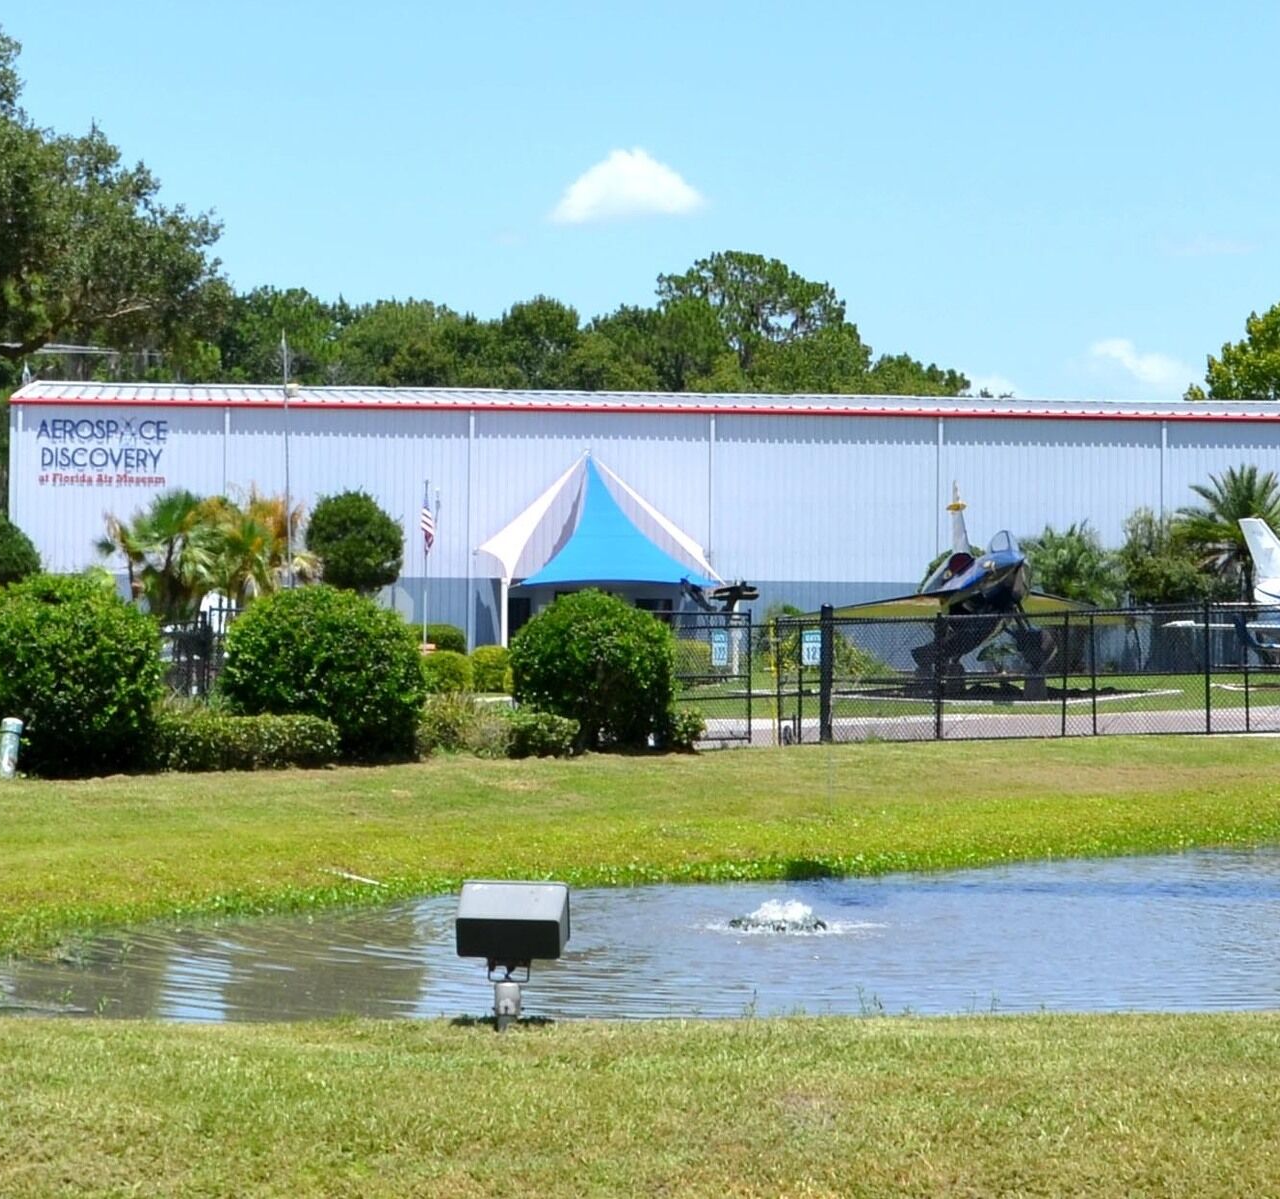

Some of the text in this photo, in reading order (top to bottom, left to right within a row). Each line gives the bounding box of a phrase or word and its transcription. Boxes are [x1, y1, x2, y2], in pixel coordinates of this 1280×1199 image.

[36, 418, 169, 441] AEROSPACE
[41, 447, 163, 469] DISCOVERY
[52, 473, 93, 484] Florida
